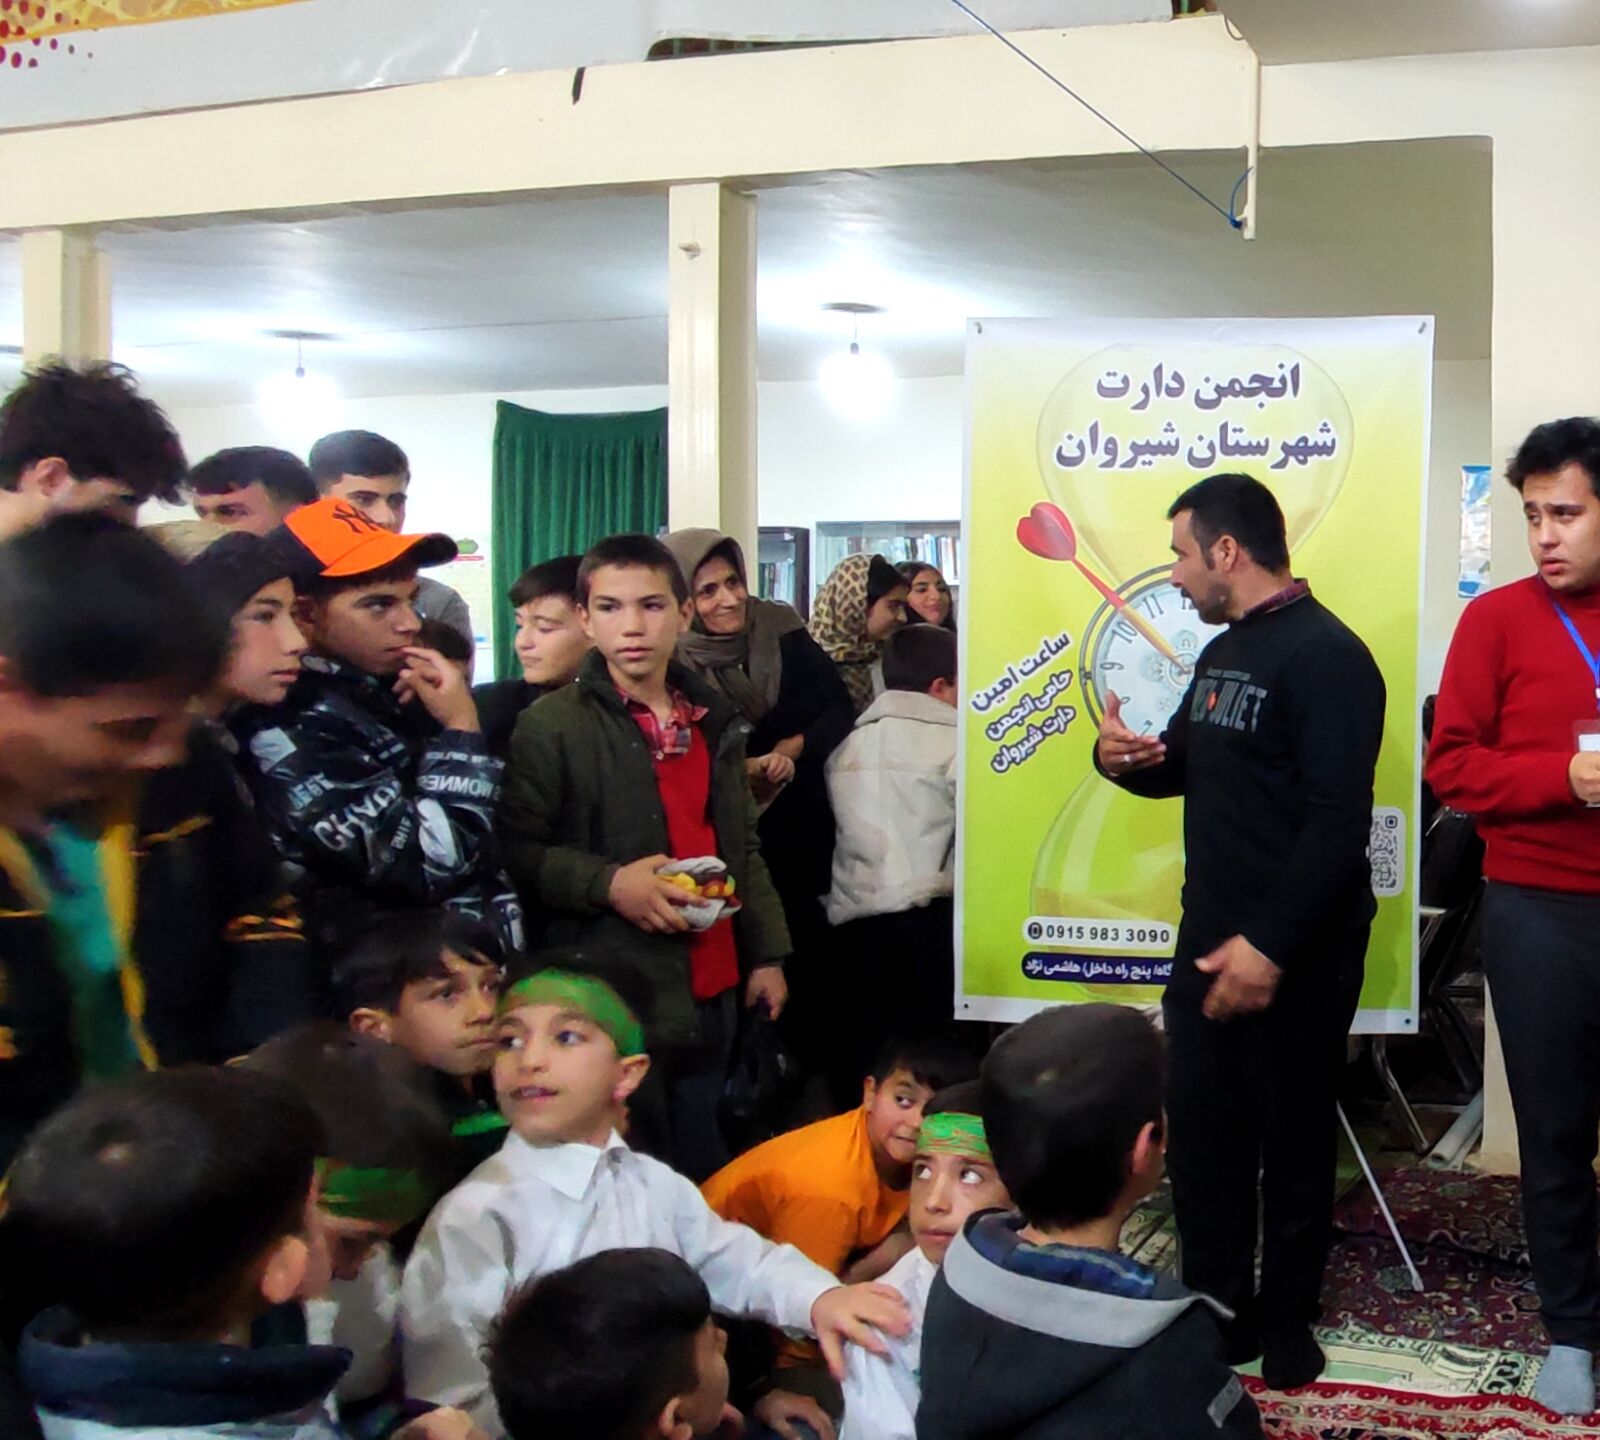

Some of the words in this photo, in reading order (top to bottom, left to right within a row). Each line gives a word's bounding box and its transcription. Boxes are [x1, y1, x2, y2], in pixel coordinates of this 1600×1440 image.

[1096, 362, 1186, 411] دارت
[1194, 362, 1300, 411] انجمن
[1056, 420, 1181, 468] شیروان
[1187, 420, 1337, 470] شهرستان
[1142, 593, 1165, 619] 11
[1019, 632, 1071, 677] ساعت
[1111, 620, 1138, 645] 10
[971, 667, 1020, 712] امین
[1034, 669, 1073, 711] حامی
[985, 693, 1036, 741] انجمن
[1041, 705, 1077, 735] دارت
[991, 723, 1045, 774] شیروان
[1046, 924, 1085, 939] 0915
[1089, 926, 1119, 941] 983
[1125, 928, 1170, 943] 3090
[1043, 960, 1081, 975] هاشمی
